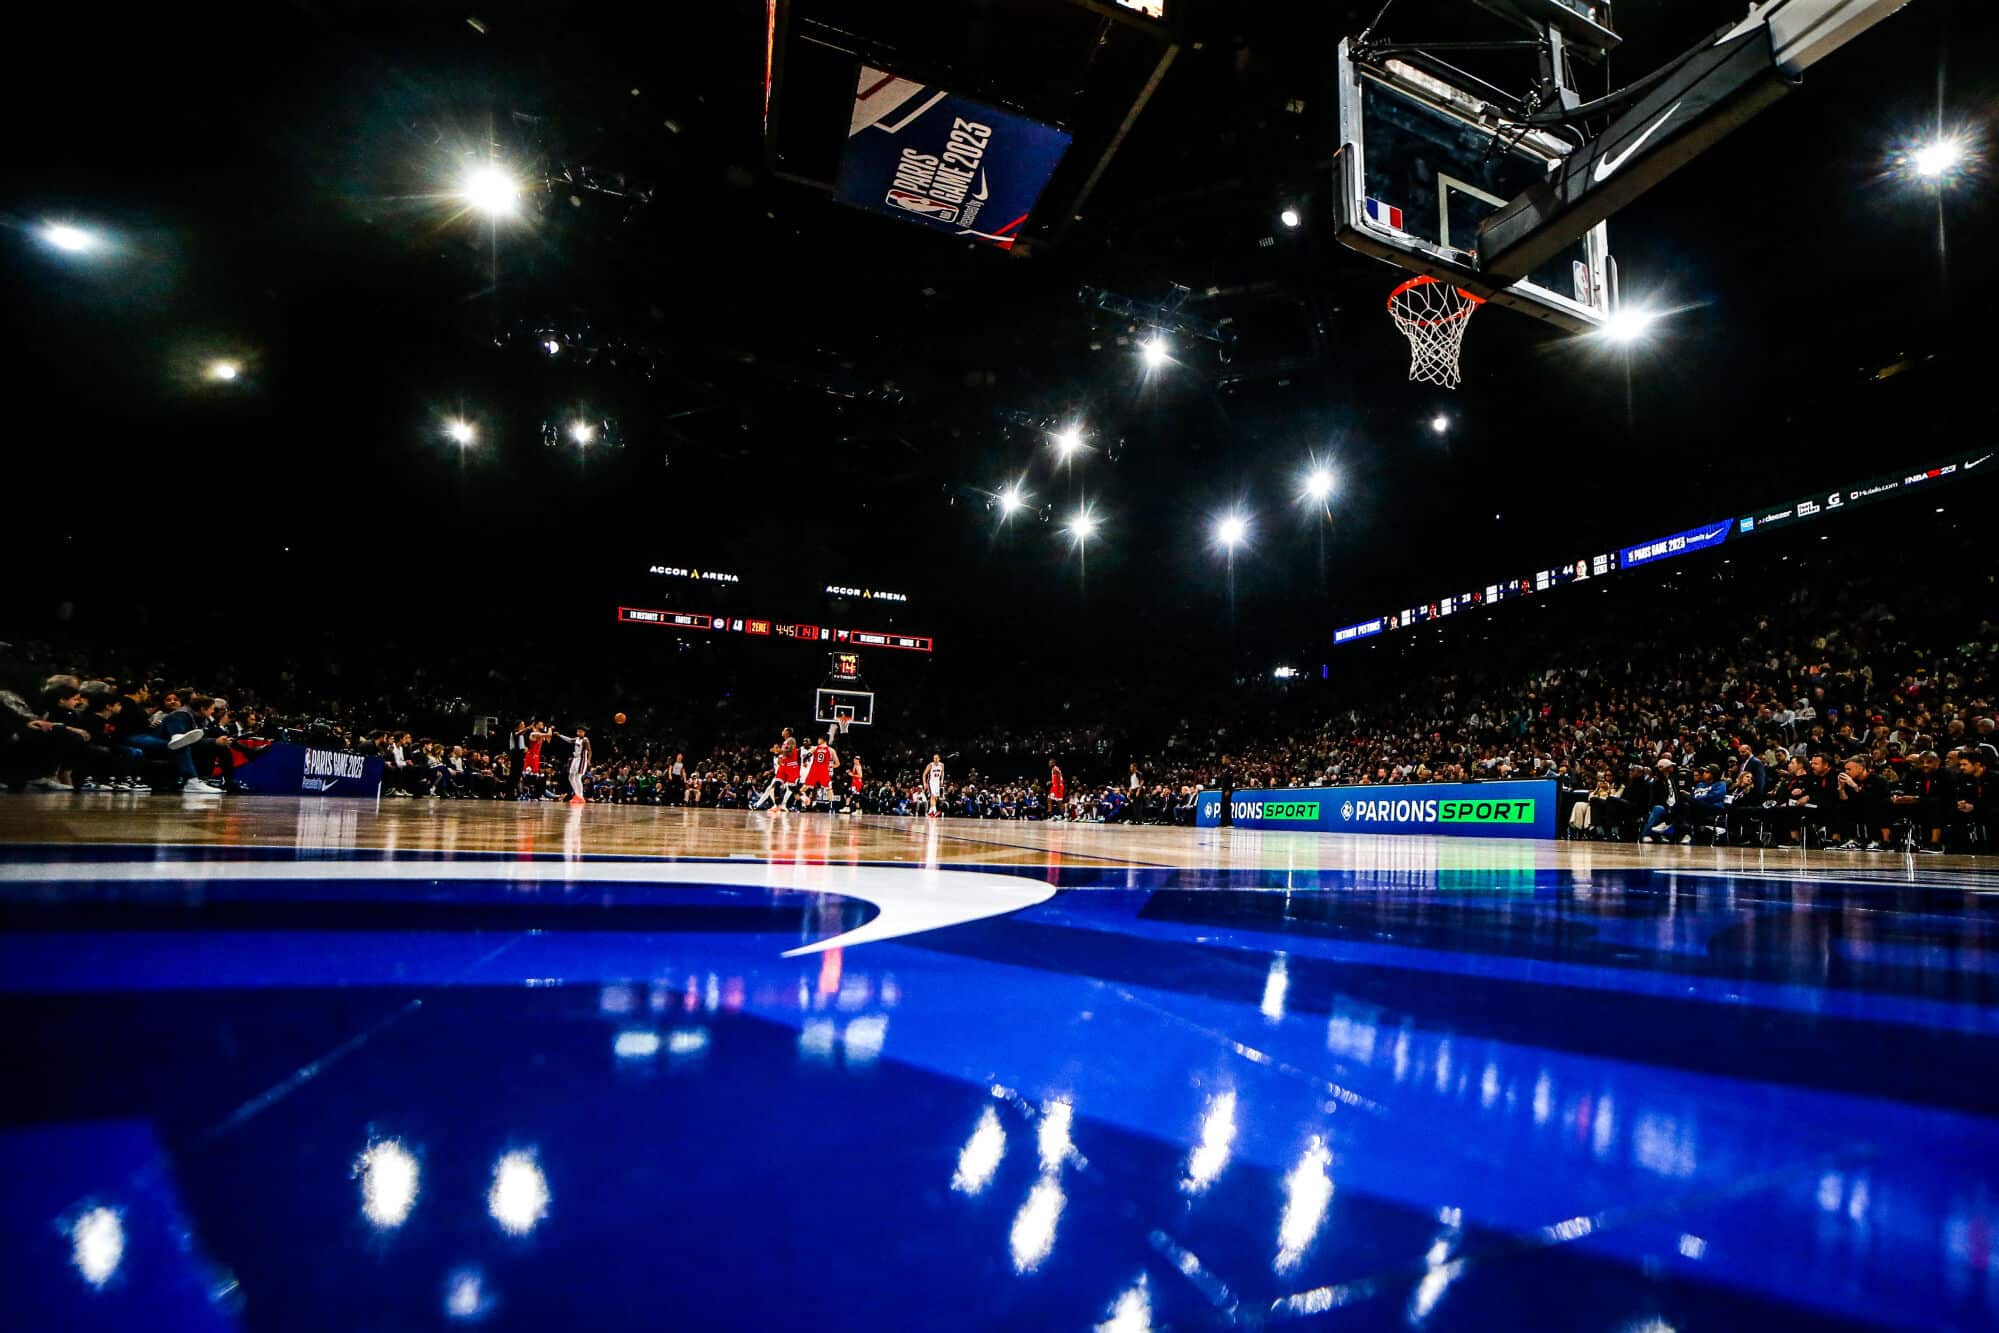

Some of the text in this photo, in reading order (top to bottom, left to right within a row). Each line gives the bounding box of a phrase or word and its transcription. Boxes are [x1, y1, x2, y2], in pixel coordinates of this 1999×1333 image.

[942, 117, 992, 170] 2023
[893, 148, 939, 195] PARIS
[929, 162, 975, 204] GAME
[649, 565, 688, 577] ACCOR
[702, 571, 739, 583] ARENA
[826, 585, 861, 596] ACCOR
[873, 591, 907, 602] ARENA
[775, 624, 795, 637] 4:45
[310, 749, 365, 779] PARIS GAME 2023
[1265, 804, 1313, 818] SPORT
[1355, 799, 1531, 823] PARIONS SPORT
